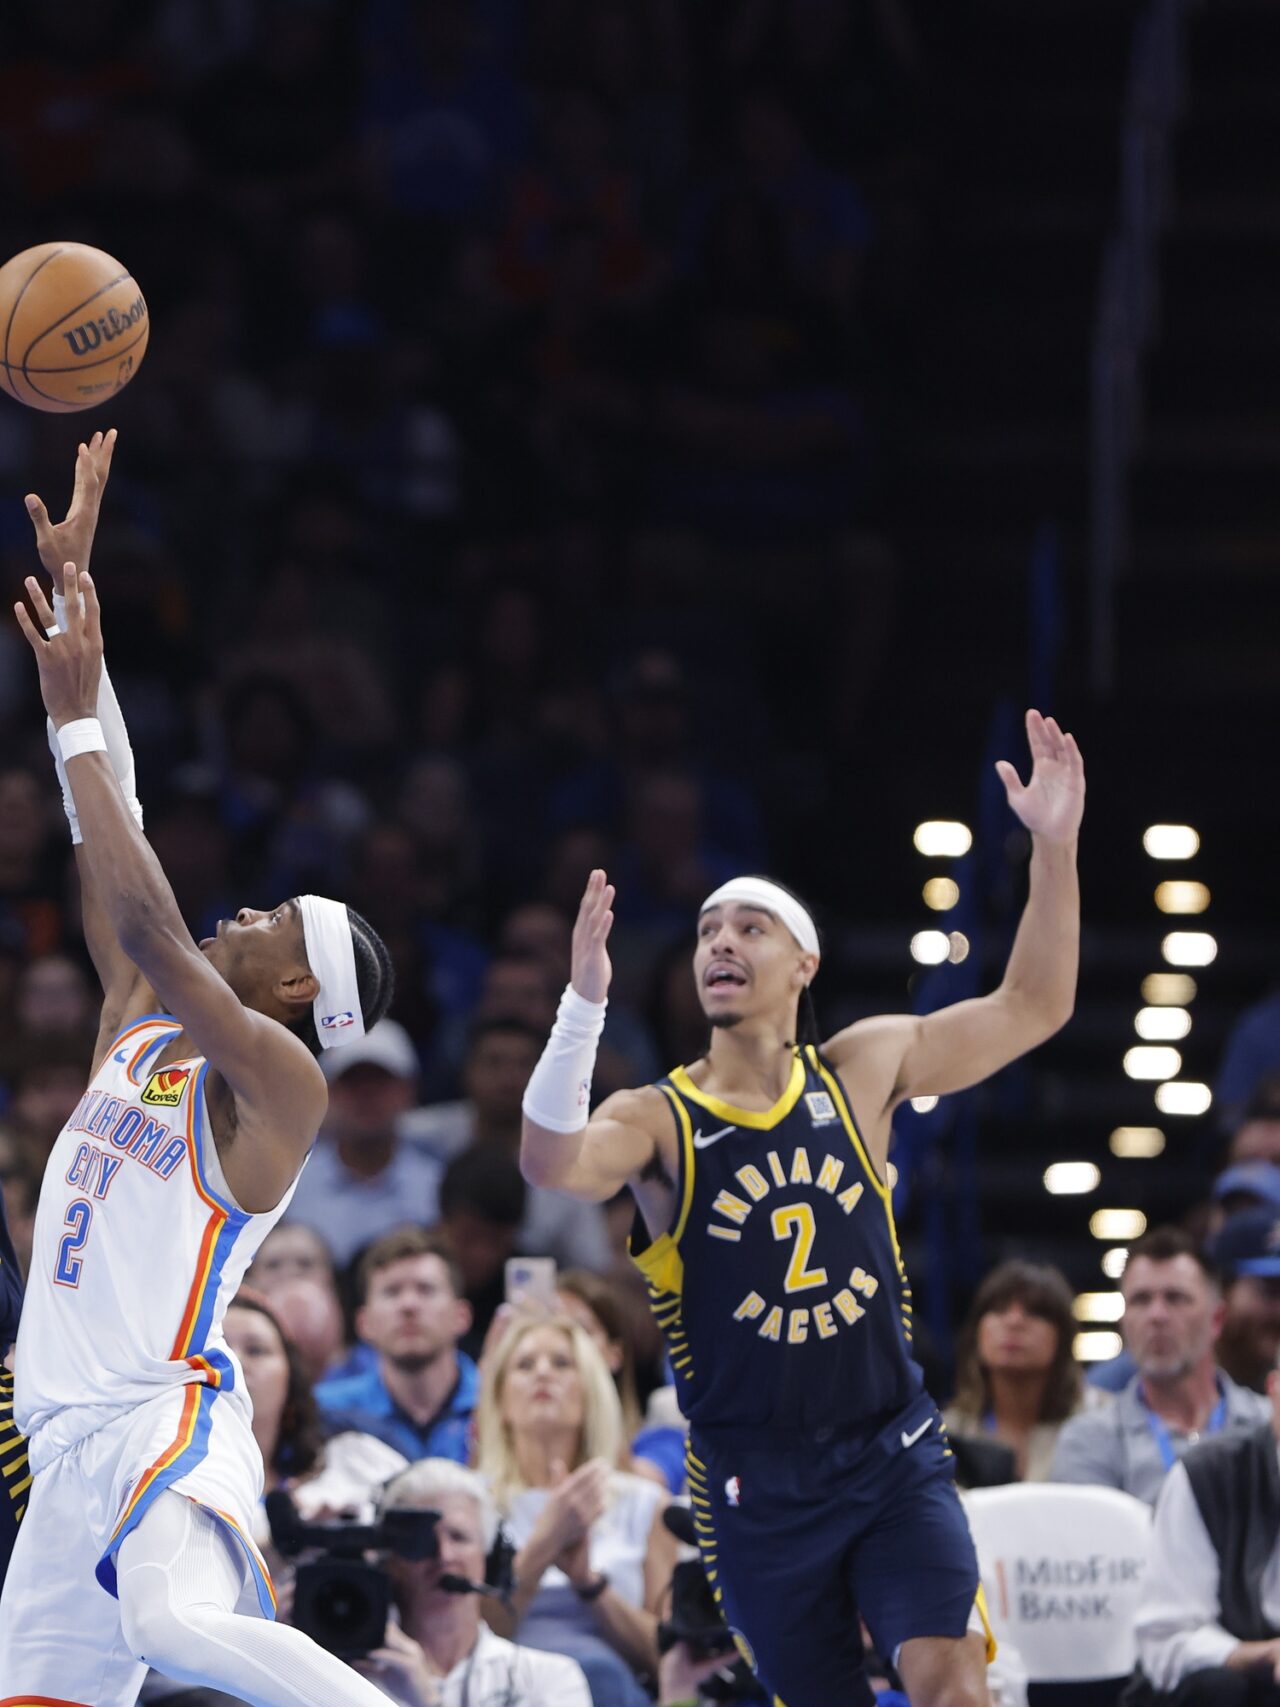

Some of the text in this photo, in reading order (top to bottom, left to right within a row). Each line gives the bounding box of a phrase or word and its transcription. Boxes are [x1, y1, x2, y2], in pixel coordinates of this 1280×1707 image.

[64, 296, 147, 356] Wilson
[67, 1090, 189, 1181] LAOMA
[707, 1147, 864, 1242] INDIANA
[54, 1198, 93, 1289] 2
[771, 1202, 828, 1294] 2
[732, 1266, 879, 1344] PACERS
